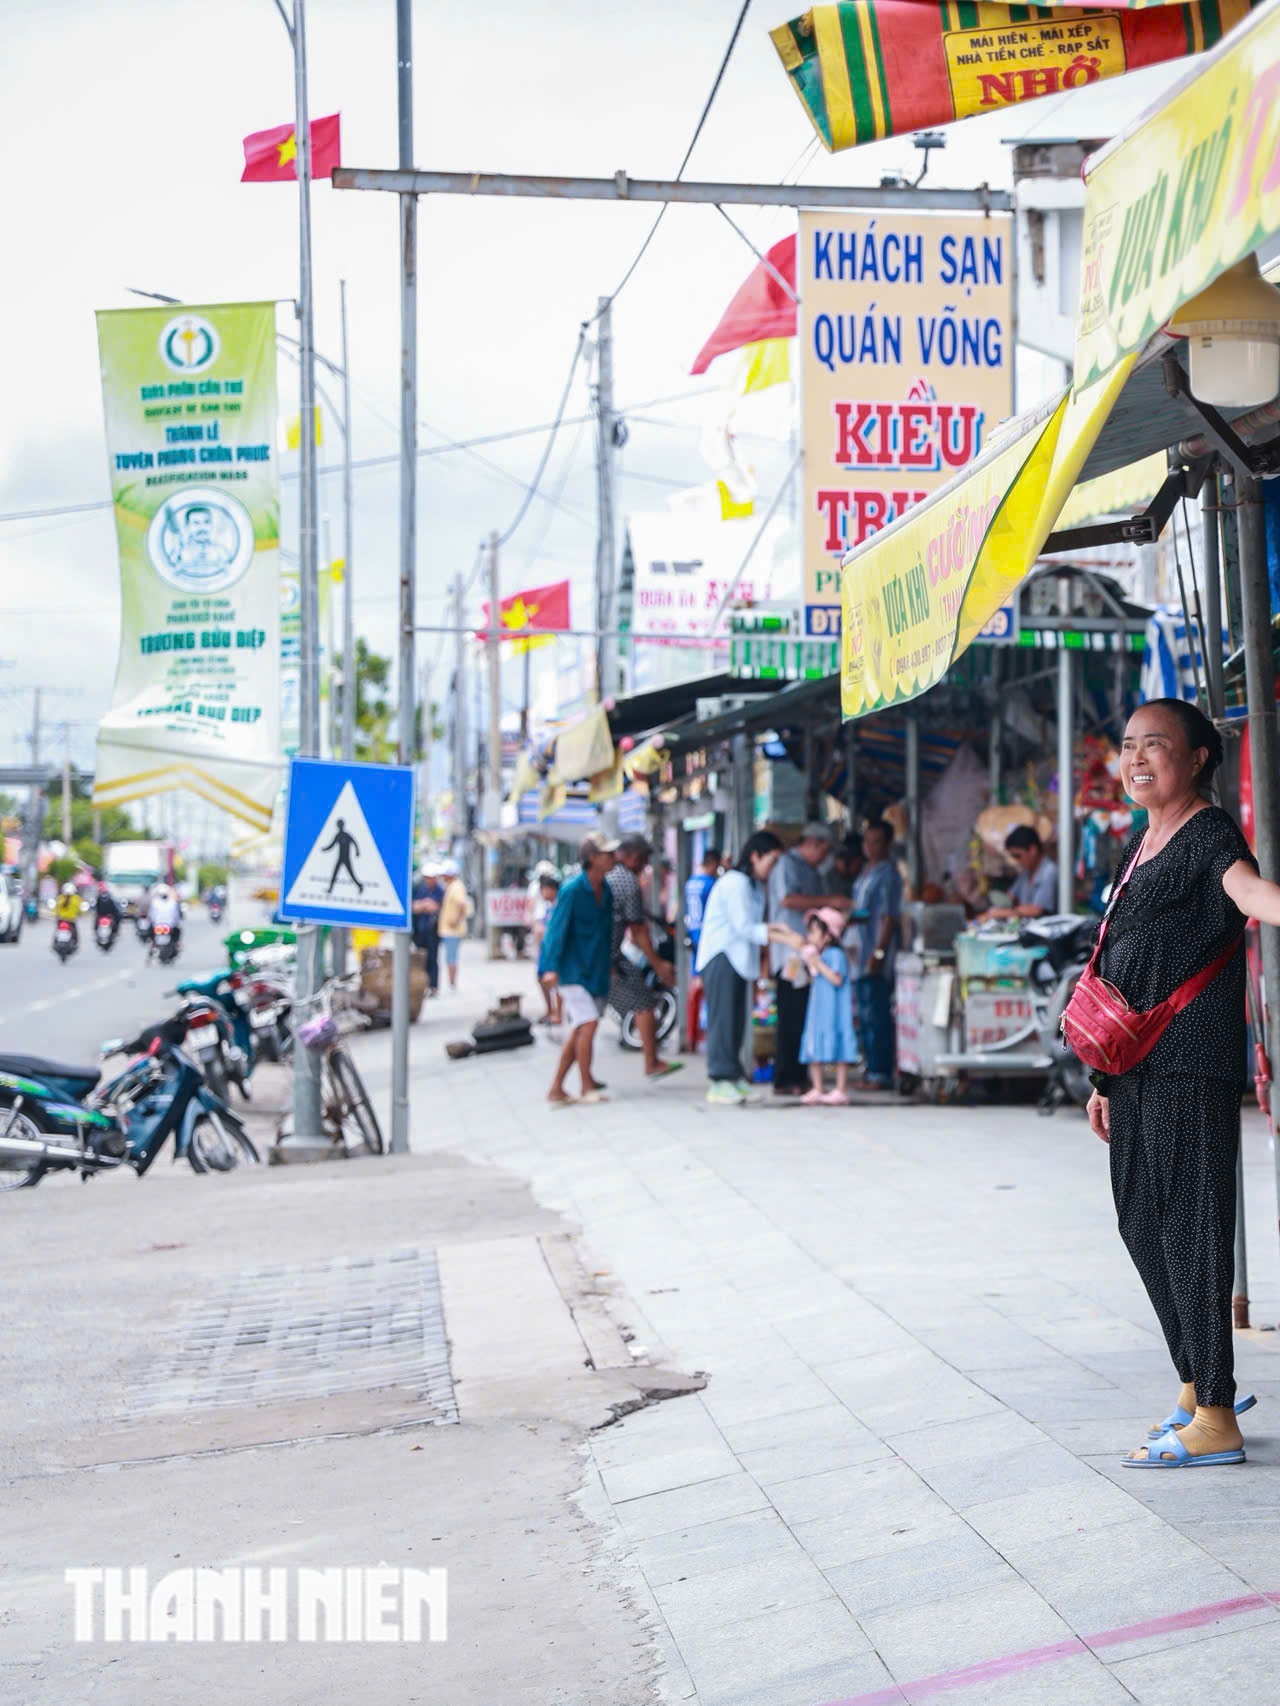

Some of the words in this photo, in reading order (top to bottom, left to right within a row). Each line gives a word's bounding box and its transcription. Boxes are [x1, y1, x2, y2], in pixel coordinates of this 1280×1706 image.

[957, 51, 983, 65] NHÀ
[1020, 42, 1045, 58] CHẾ
[1058, 42, 1083, 55] RẠP
[970, 34, 994, 48] MÁI
[998, 32, 1028, 45] HIÊN
[1040, 27, 1064, 41] MÁI
[815, 220, 923, 283] KHÁCH
[940, 235, 1003, 296] SẠN
[814, 302, 902, 372] QUÁN
[918, 305, 1003, 367] VÕNG
[835, 379, 984, 470] KIỀU
